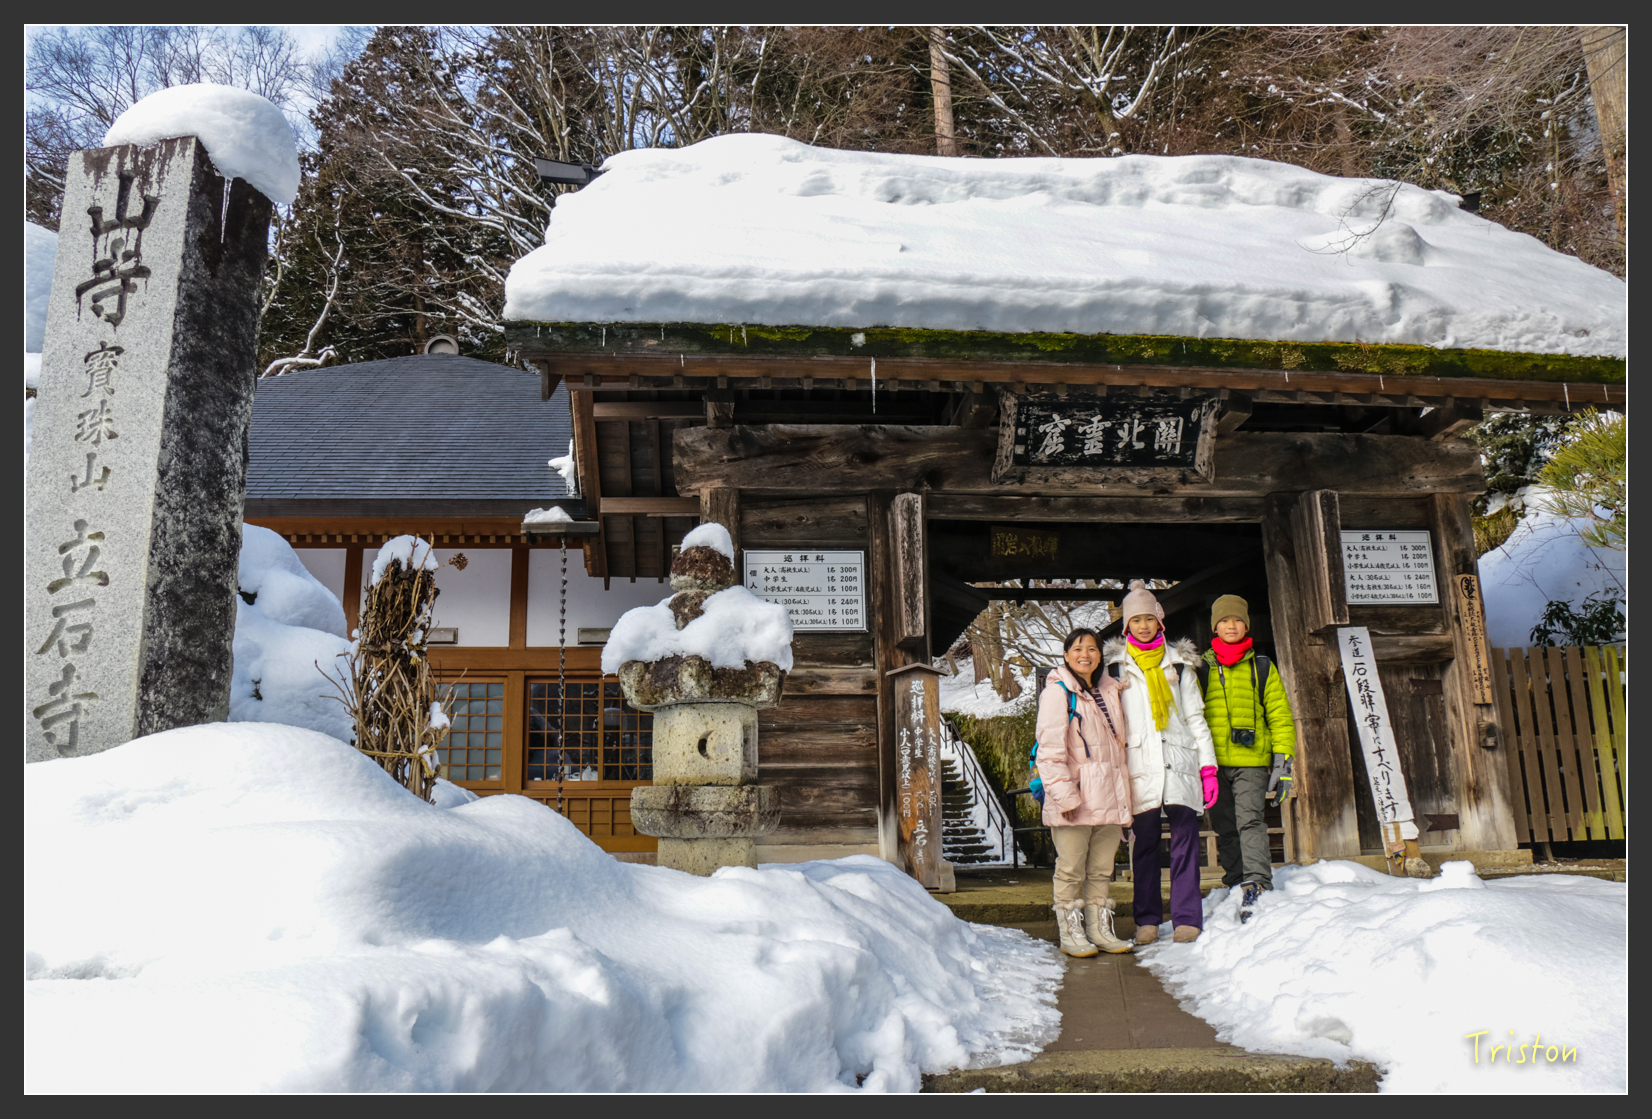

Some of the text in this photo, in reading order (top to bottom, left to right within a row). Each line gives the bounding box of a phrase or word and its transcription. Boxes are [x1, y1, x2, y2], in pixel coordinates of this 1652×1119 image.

[75, 169, 162, 327] 山寺
[33, 518, 110, 758] 立石寺
